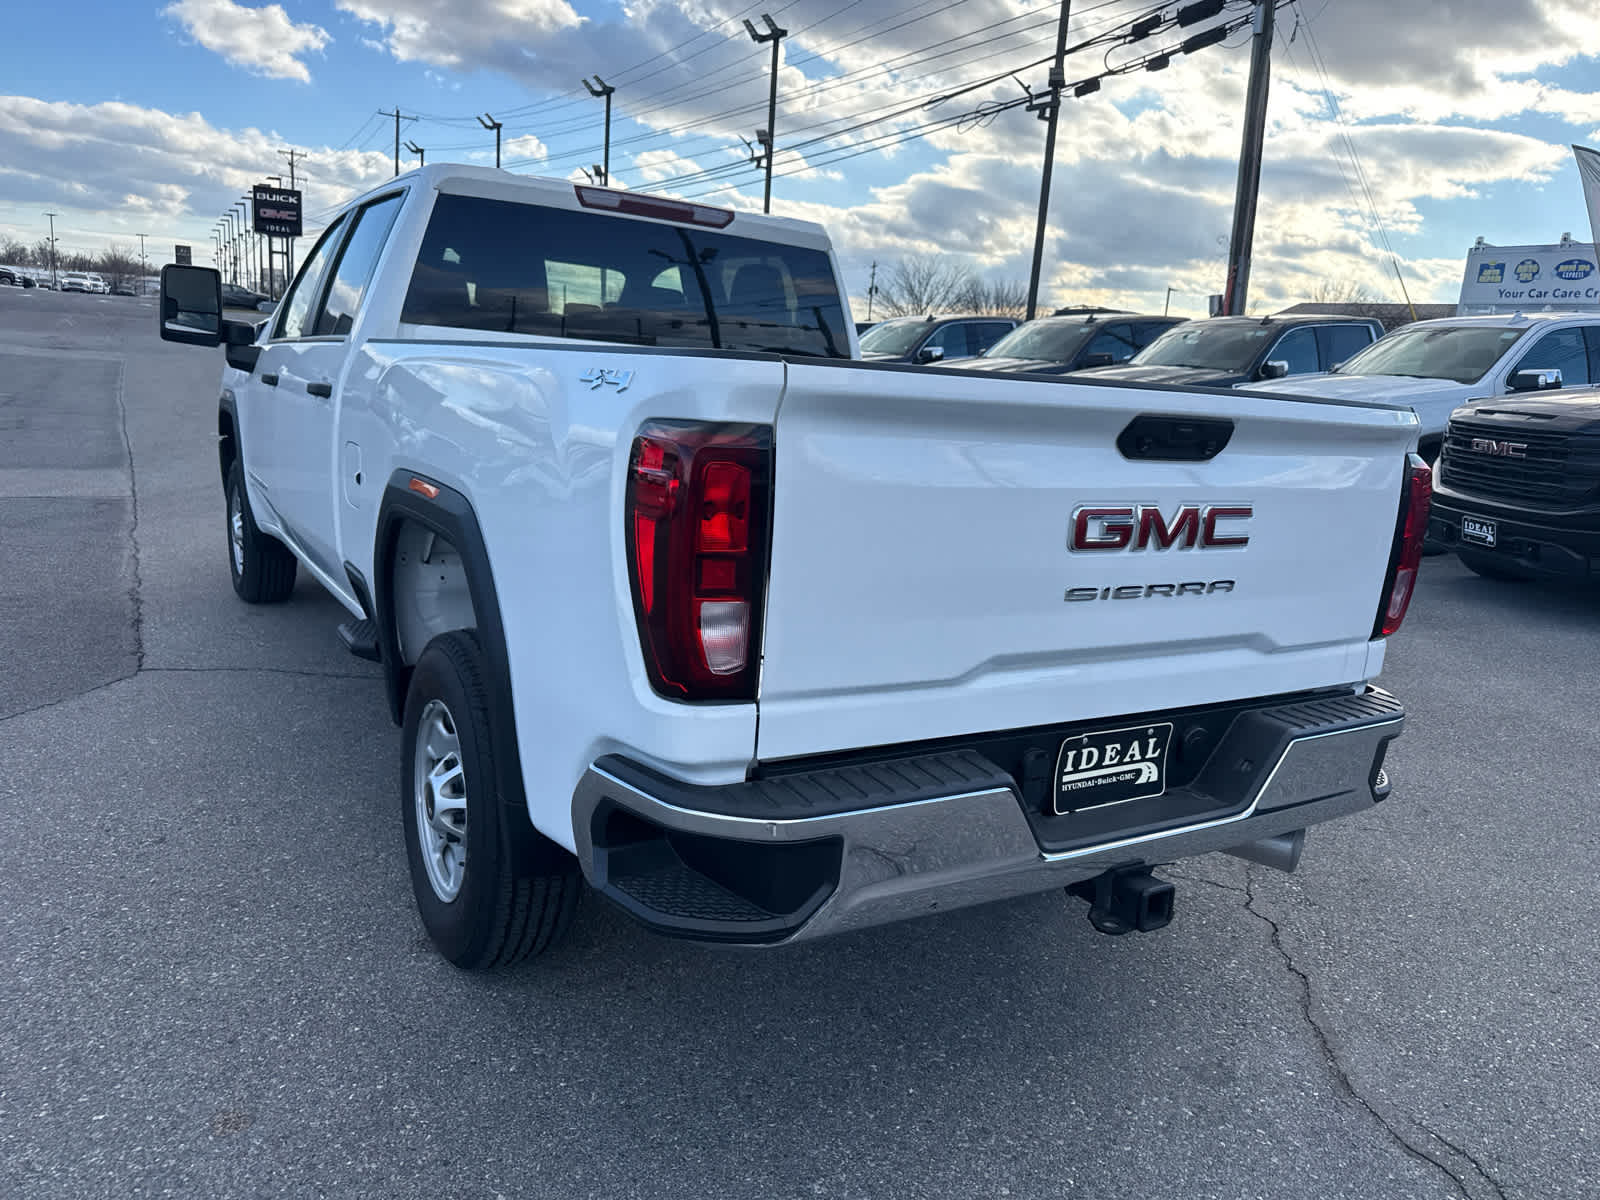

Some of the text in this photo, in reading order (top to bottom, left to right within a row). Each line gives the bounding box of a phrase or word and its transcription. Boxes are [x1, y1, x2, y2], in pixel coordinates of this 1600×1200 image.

[256, 192, 298, 204] BUICK
[259, 208, 297, 221] GMC
[265, 224, 290, 233] IDEAL
[1499, 289, 1524, 298] Your
[1528, 288, 1549, 298] Car
[1552, 288, 1581, 298] Care
[1471, 438, 1528, 459] GMC
[1067, 503, 1254, 553] GMC
[1464, 520, 1495, 535] IDEAL
[1064, 579, 1236, 602] SIERRA
[1063, 737, 1161, 773] IDEAL
